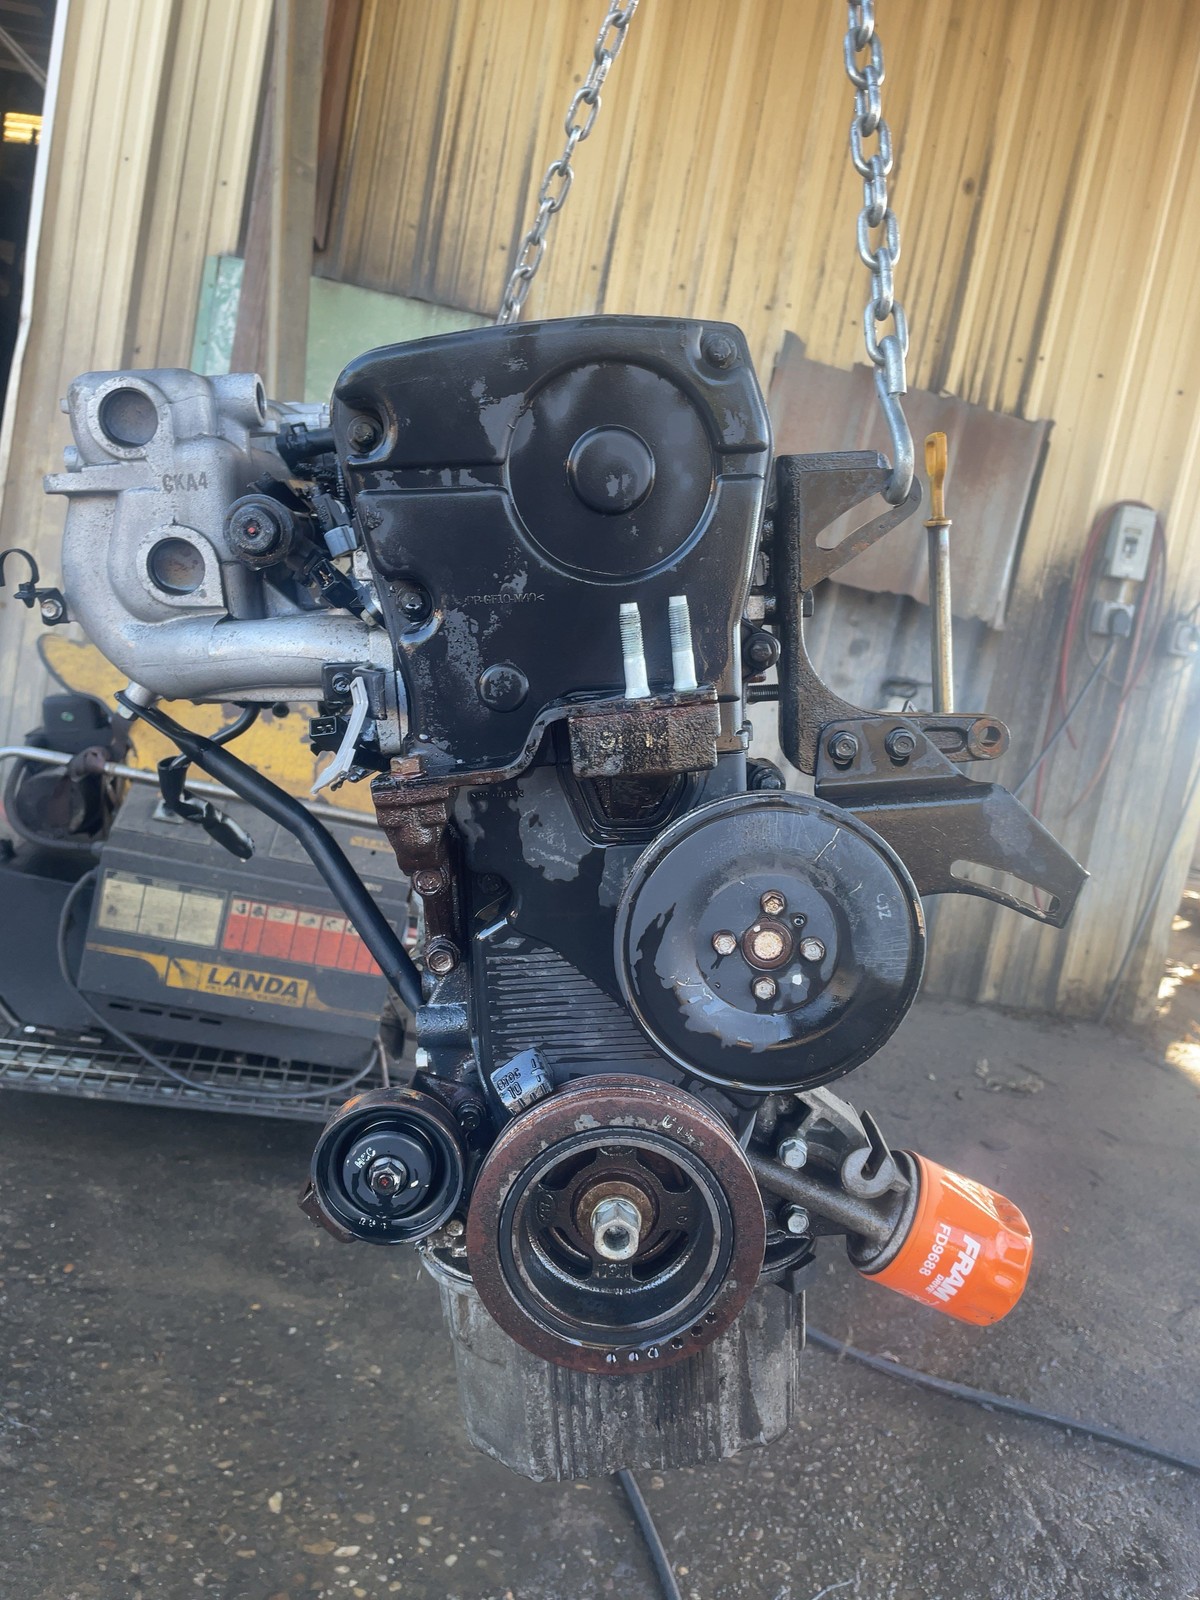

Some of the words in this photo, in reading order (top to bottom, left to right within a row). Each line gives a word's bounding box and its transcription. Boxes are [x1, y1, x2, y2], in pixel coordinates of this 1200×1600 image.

[208, 967, 299, 998] LANDA
[919, 1223, 951, 1276] FD9688
[932, 1234, 981, 1302] FRAM
